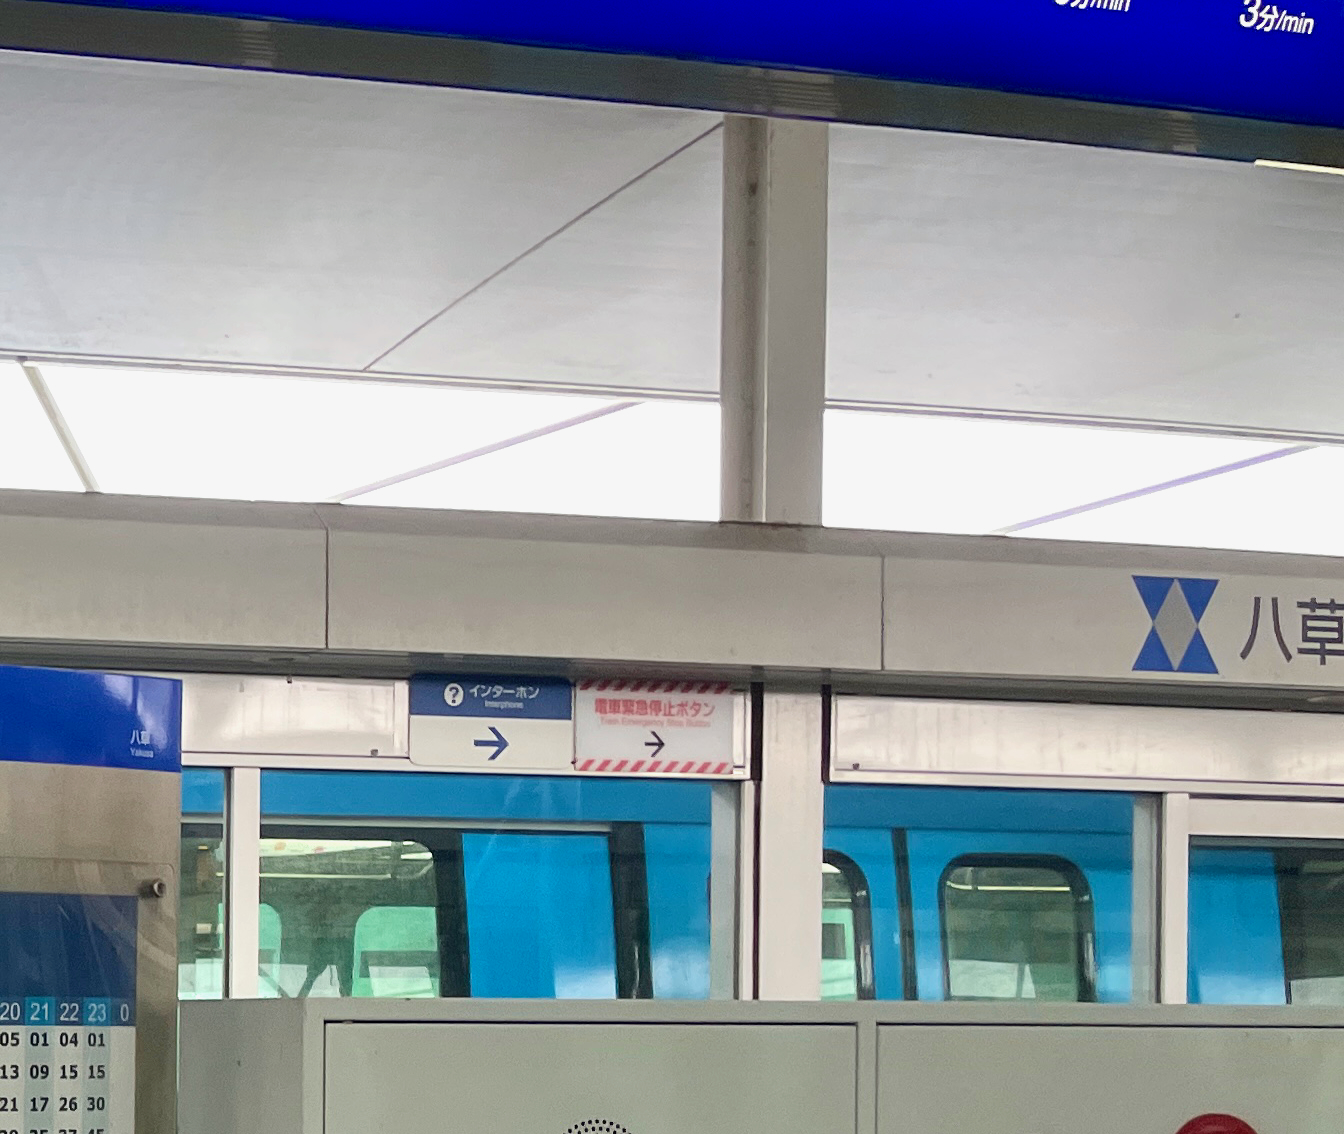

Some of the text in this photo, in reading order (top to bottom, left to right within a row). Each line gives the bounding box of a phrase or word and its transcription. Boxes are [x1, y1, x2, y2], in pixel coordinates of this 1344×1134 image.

[1239, 0, 1314, 35] 3分/min
[1240, 596, 1344, 666] 八草
[469, 684, 540, 699] インターホン
[0, 1002, 21, 1021] 20
[30, 1003, 49, 1021] 21
[59, 1003, 79, 1022] 22
[87, 1003, 107, 1022] 23
[120, 1003, 129, 1022] 0
[0, 1032, 19, 1046] 05
[30, 1032, 49, 1046] 01
[60, 1033, 78, 1047] 04
[88, 1033, 105, 1047] 01
[0, 1065, 19, 1079] 13
[30, 1065, 49, 1079] 09
[60, 1065, 77, 1079] 15
[89, 1065, 105, 1079] 15
[0, 1097, 18, 1111] 21
[30, 1097, 49, 1112] 17
[59, 1097, 77, 1111] 26
[87, 1097, 105, 1111] 30
